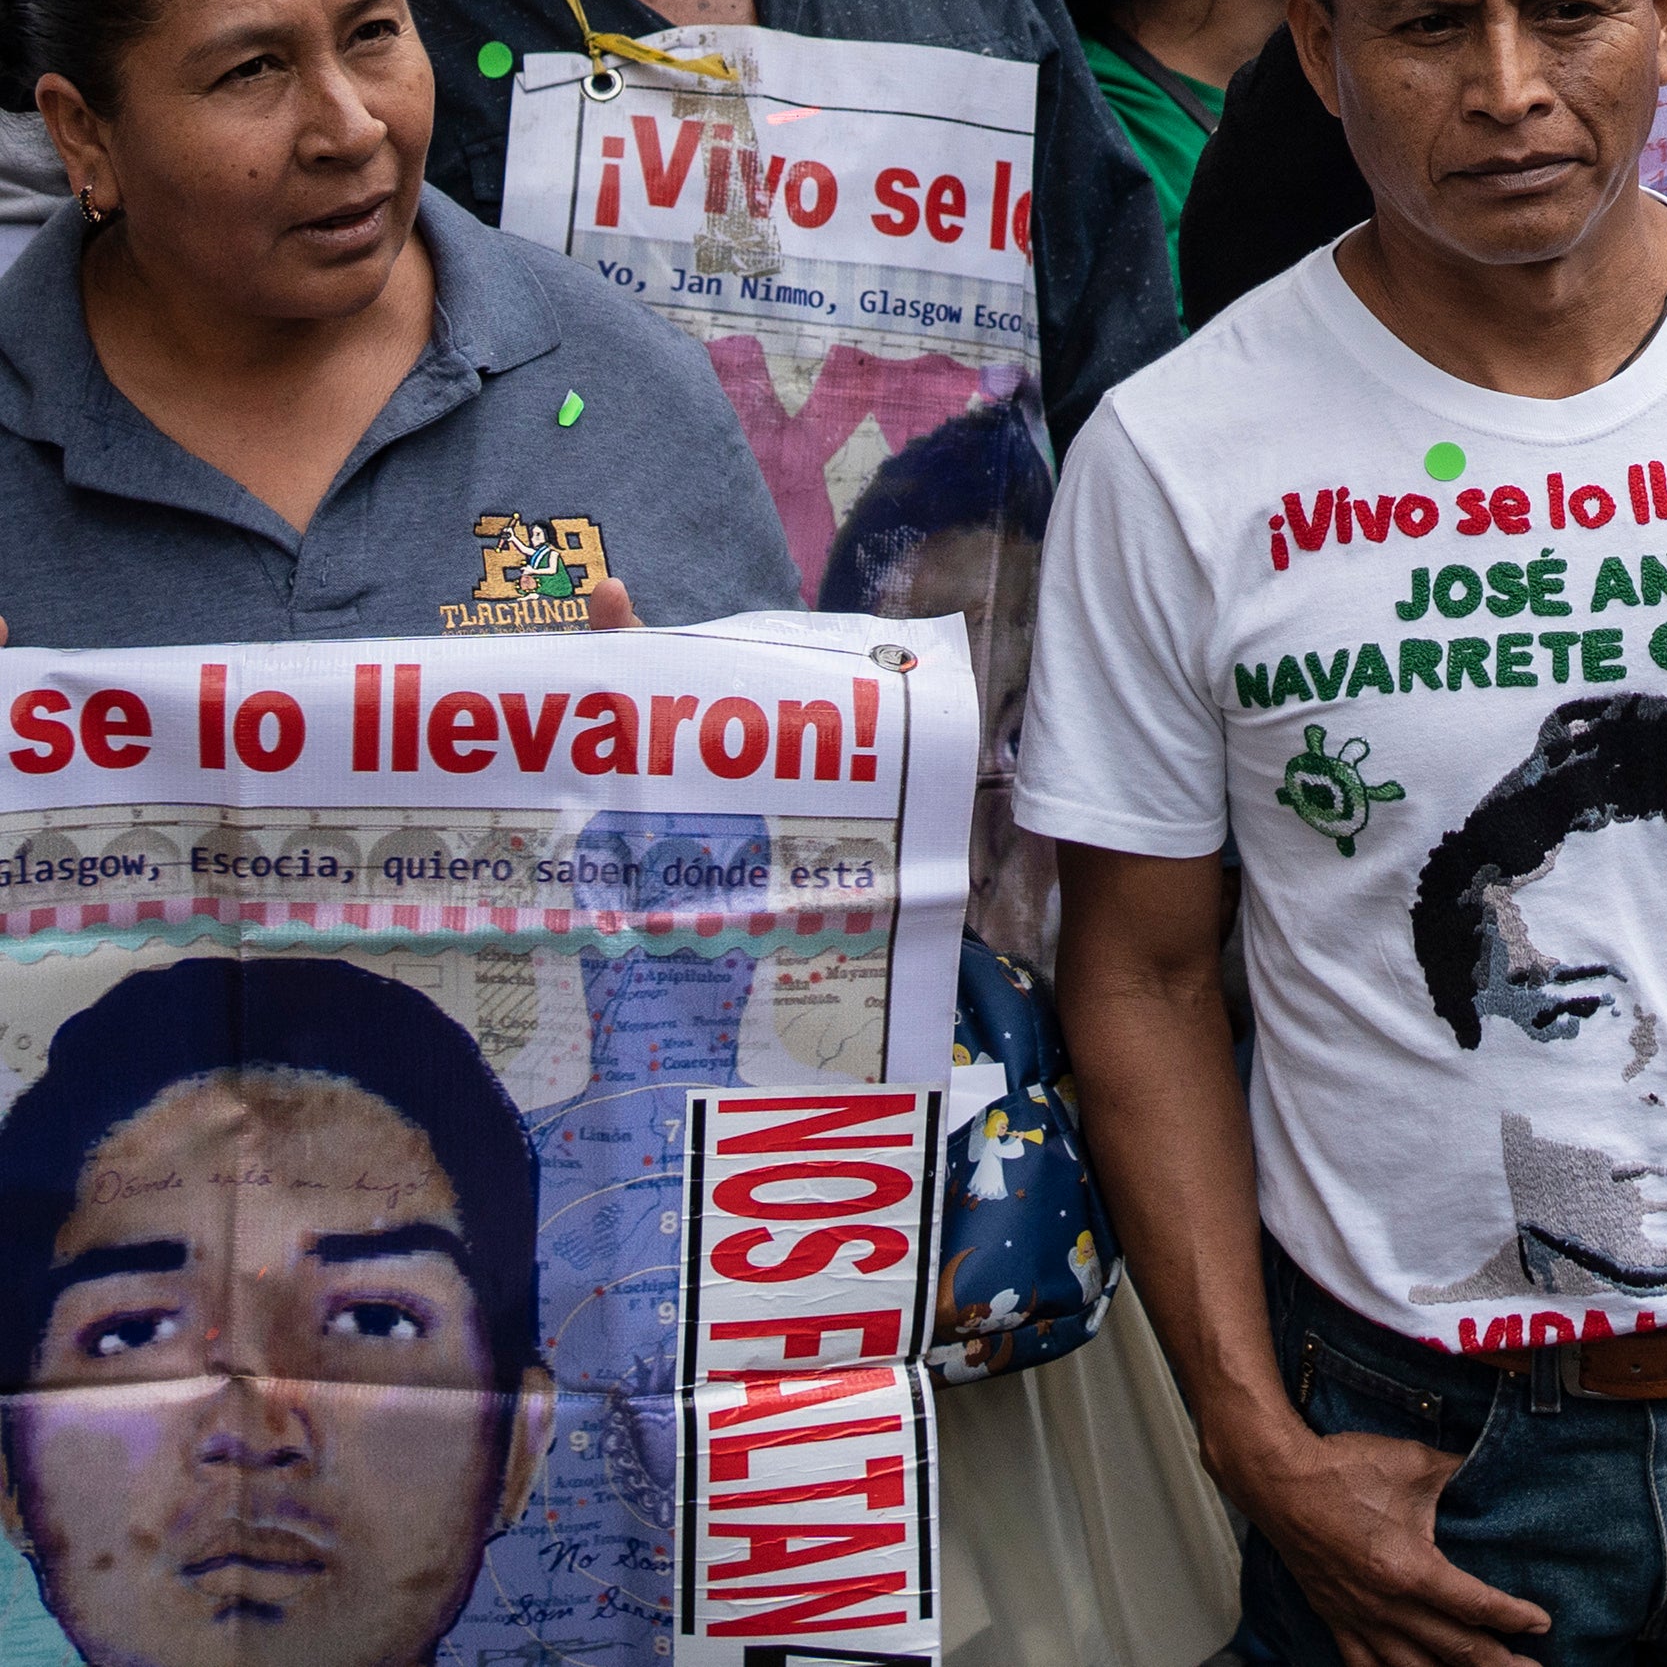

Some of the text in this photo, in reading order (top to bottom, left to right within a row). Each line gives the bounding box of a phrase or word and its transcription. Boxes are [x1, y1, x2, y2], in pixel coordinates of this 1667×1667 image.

[594, 116, 838, 229] ¡Vivo
[871, 163, 966, 245] se
[598, 259, 647, 294] Yo,
[671, 268, 722, 296] Jan
[740, 276, 838, 316] Nimmo,
[859, 290, 962, 327] Glasgow
[1269, 488, 1438, 570] ¡Vivo
[1456, 486, 1530, 535] se
[1547, 474, 1615, 529] lo
[1396, 549, 1571, 621] JOSÉ
[1235, 629, 1626, 708] NAVARRETE
[10, 665, 877, 781] se lo llevaron!
[190, 847, 356, 883] Escocia,
[382, 850, 513, 888] quiero
[662, 848, 769, 889] dónde
[789, 853, 877, 889] está
[710, 1093, 917, 1284] NOS
[706, 1309, 907, 1637] FALTAN
